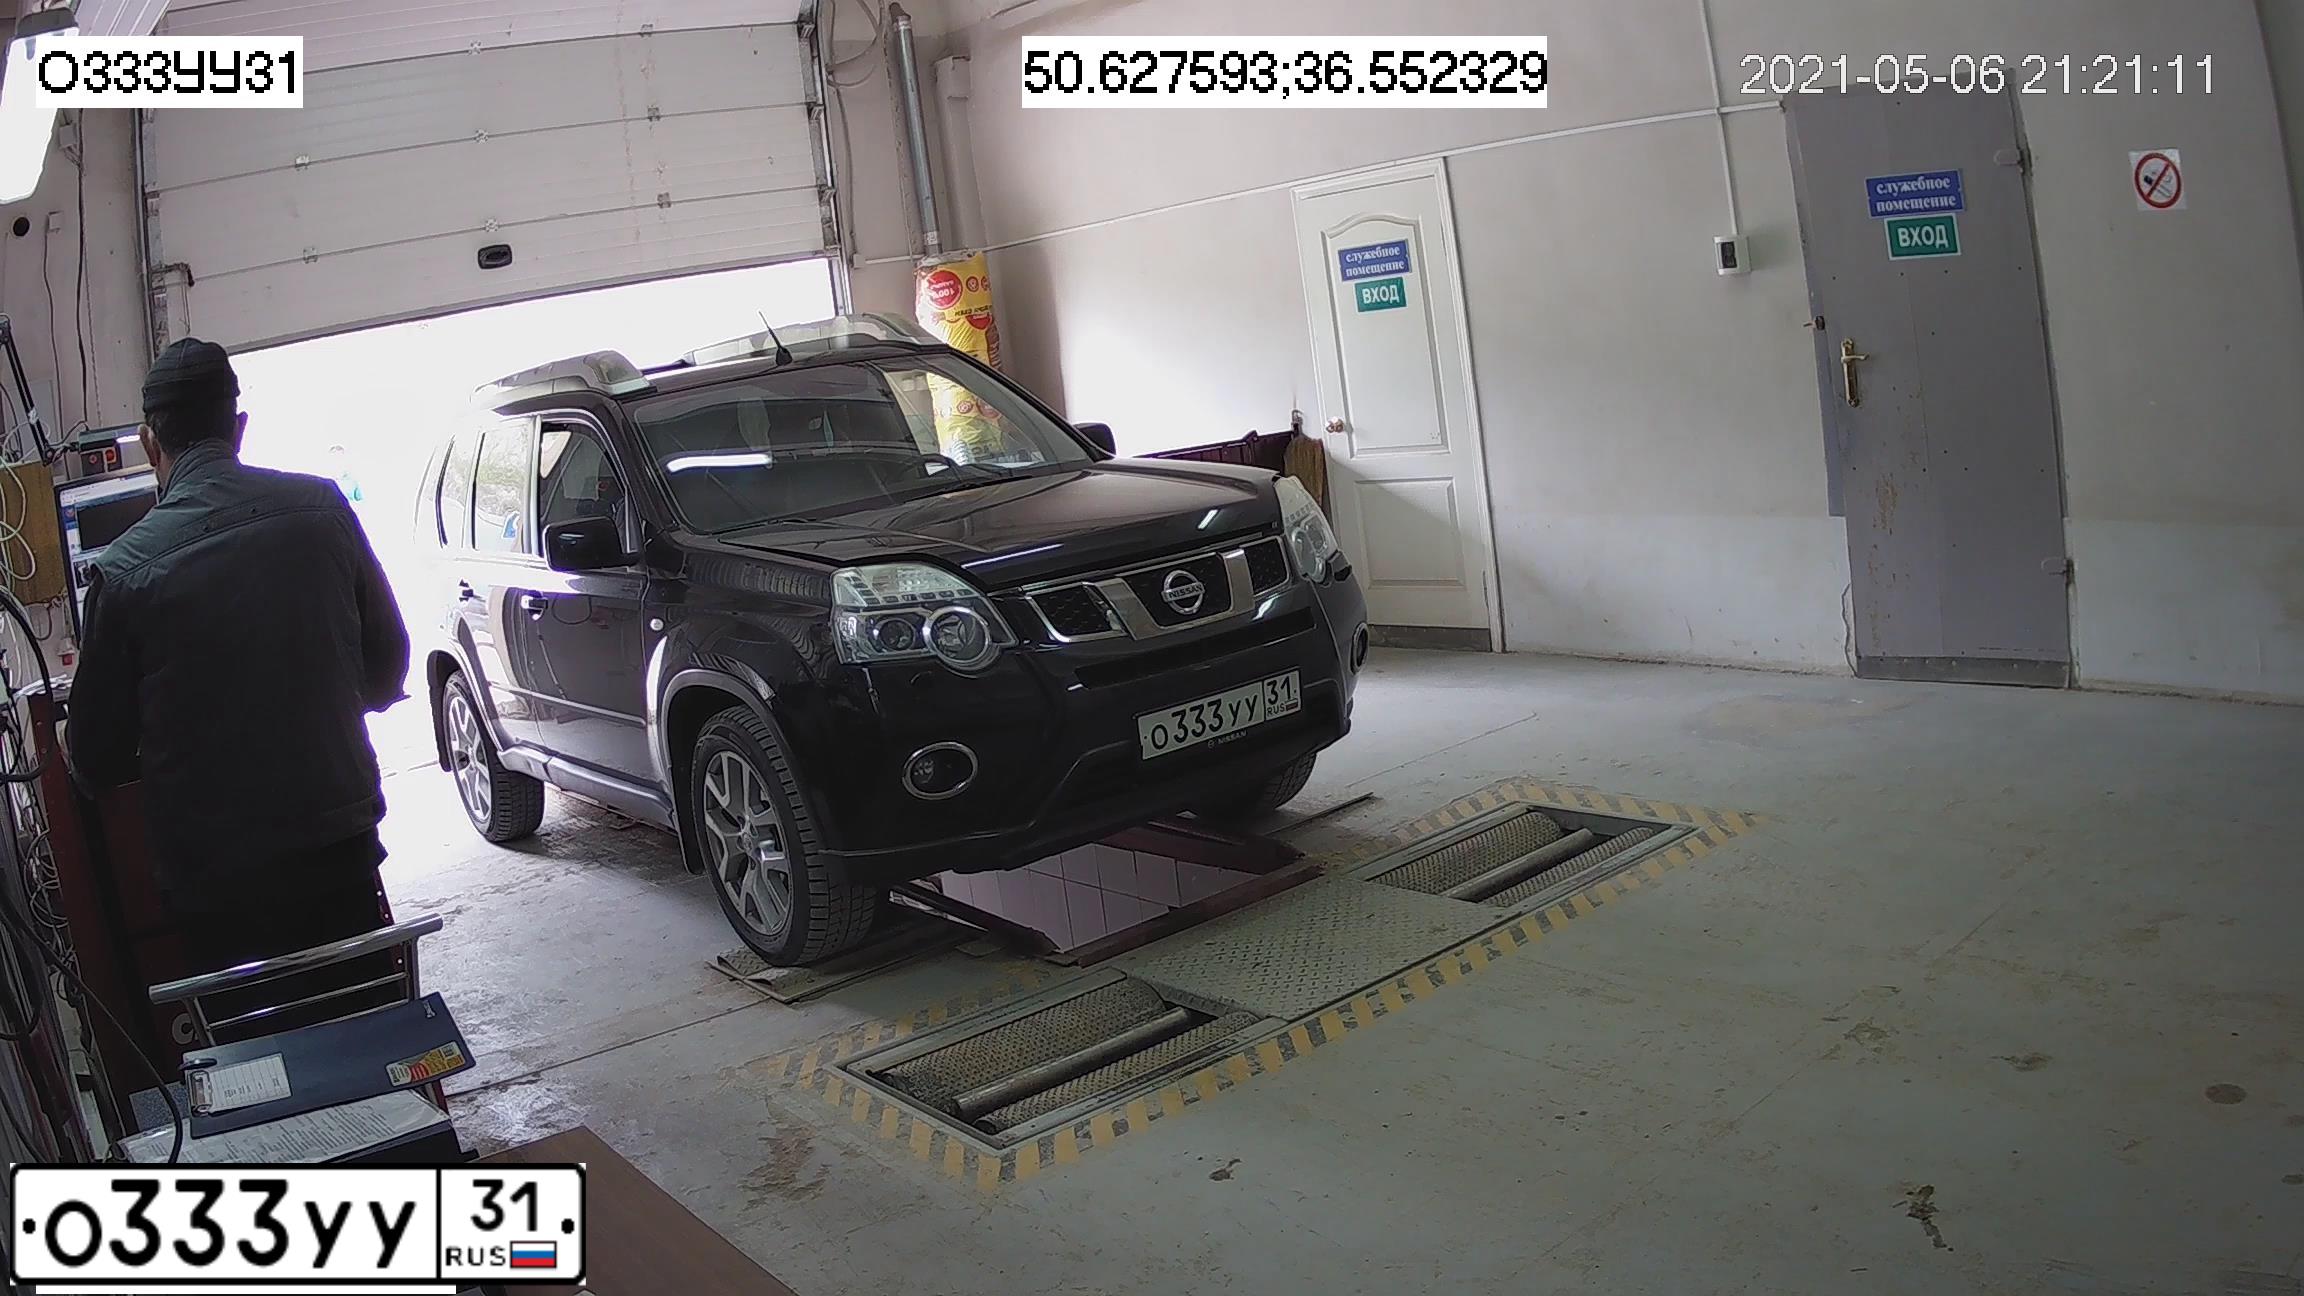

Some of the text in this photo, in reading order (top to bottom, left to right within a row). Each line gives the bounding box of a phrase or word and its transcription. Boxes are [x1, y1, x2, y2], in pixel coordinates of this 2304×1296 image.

[1876, 176, 1951, 197] служебное
[1876, 195, 1956, 213] помещение
[1897, 224, 1949, 248] ВХОД
[1345, 246, 1400, 263] служебное
[1346, 260, 1405, 277] помещение
[1362, 284, 1400, 304] ВХОД
[1168, 584, 1203, 599] NISSAN
[1267, 676, 1292, 705] 31
[1267, 703, 1286, 717] RUS
